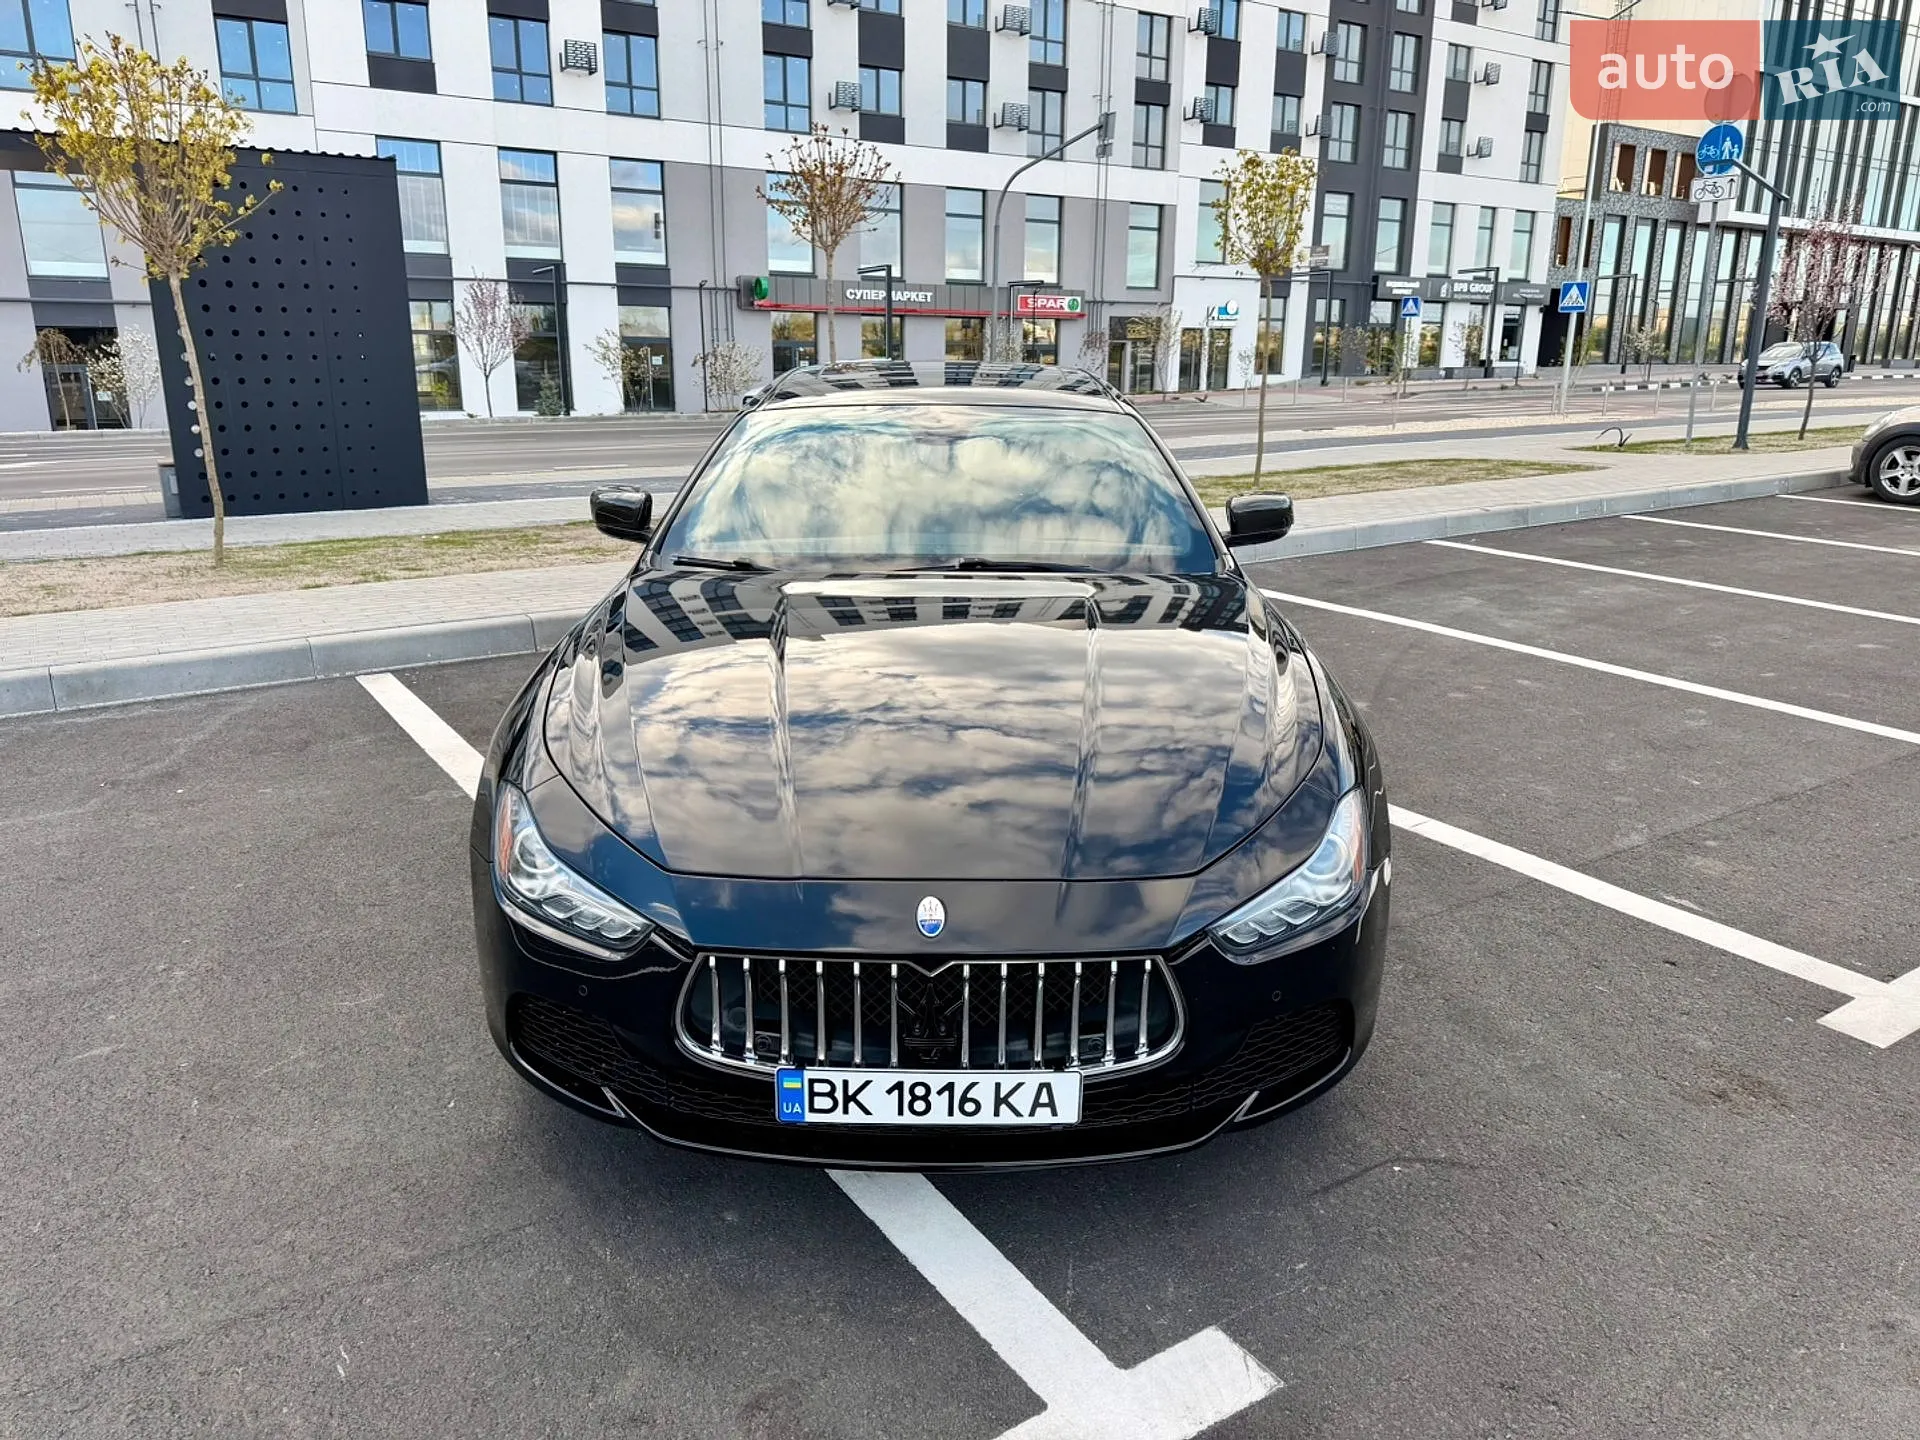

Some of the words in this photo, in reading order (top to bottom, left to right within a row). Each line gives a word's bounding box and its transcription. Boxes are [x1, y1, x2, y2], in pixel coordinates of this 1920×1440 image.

[1027, 297, 1066, 310] SPAR
[808, 1078, 873, 1116] BK
[885, 1080, 982, 1117] 1816
[993, 1081, 1059, 1118] KA
[783, 1102, 802, 1114] UA
